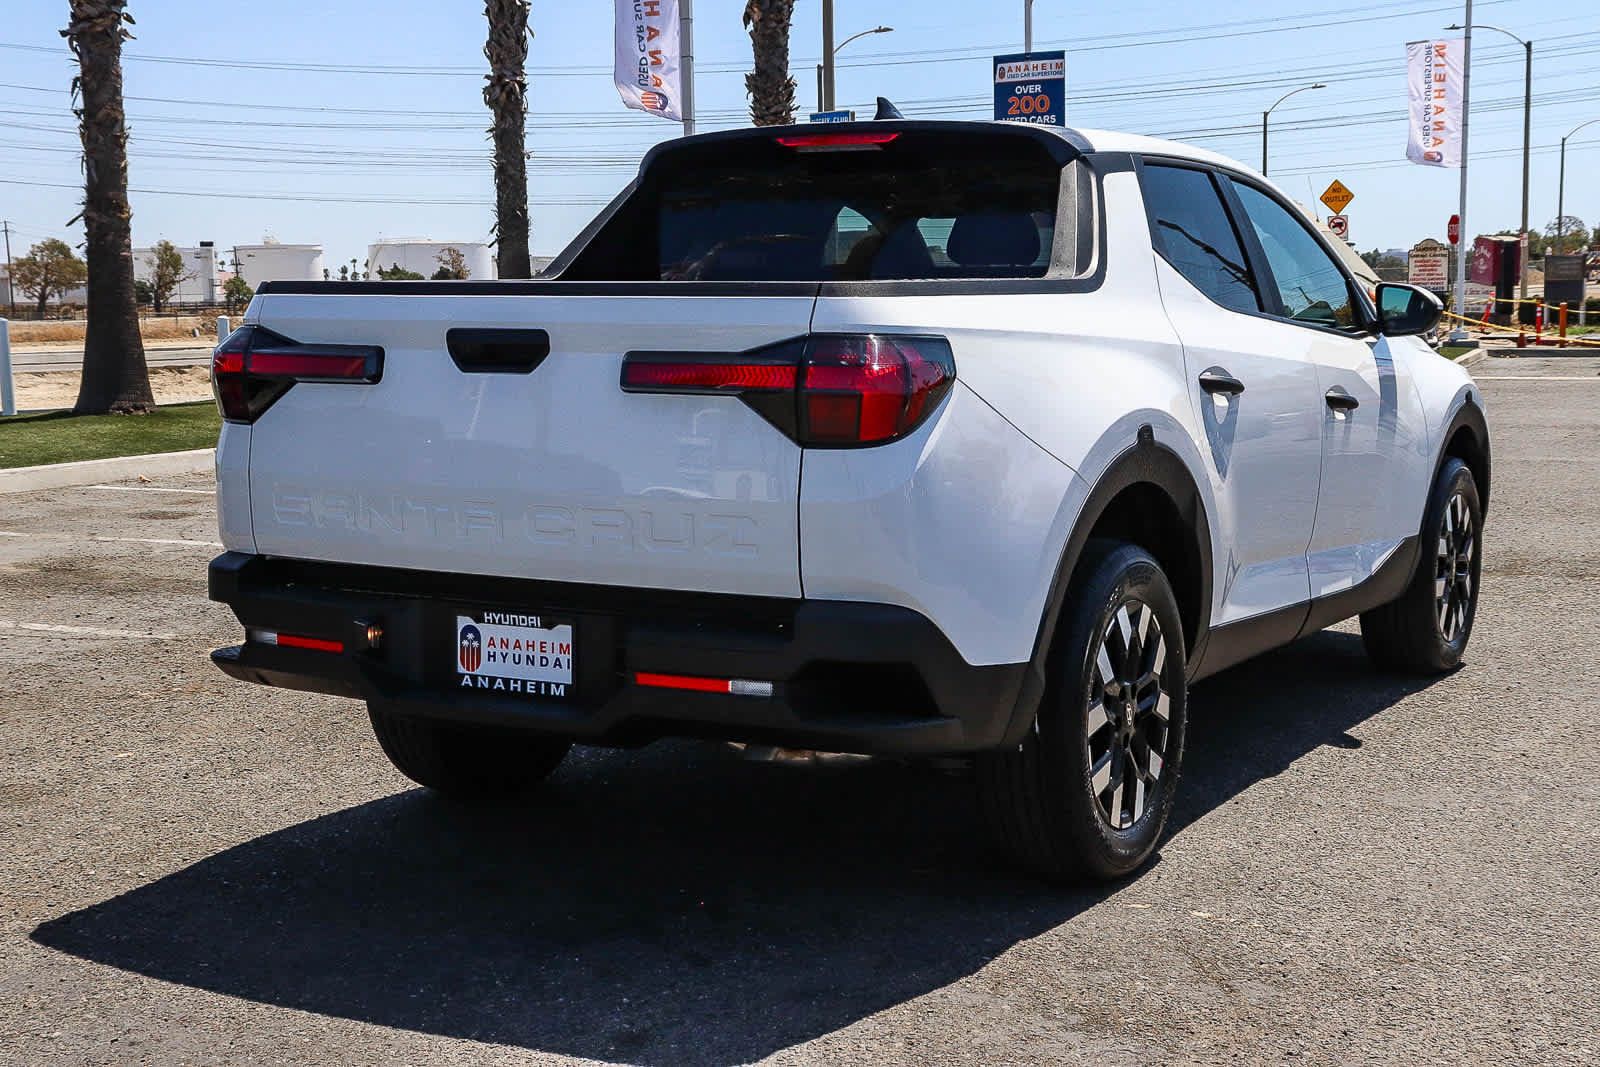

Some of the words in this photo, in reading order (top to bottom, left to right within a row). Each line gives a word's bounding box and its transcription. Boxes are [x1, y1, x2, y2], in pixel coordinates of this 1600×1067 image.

[1007, 62, 1063, 73] ANAHEIM
[1015, 85, 1042, 95] OVER
[1007, 95, 1050, 115] 200
[1029, 114, 1057, 124] CARS
[1325, 195, 1349, 203] OUTLET
[271, 494, 504, 541] SANTA
[524, 504, 760, 559] CRUZ
[484, 612, 541, 627] HYUNDAI
[487, 636, 571, 655] ANAHEIM
[487, 650, 571, 670] HYUNDAI
[461, 675, 565, 696] ANAHEIM
